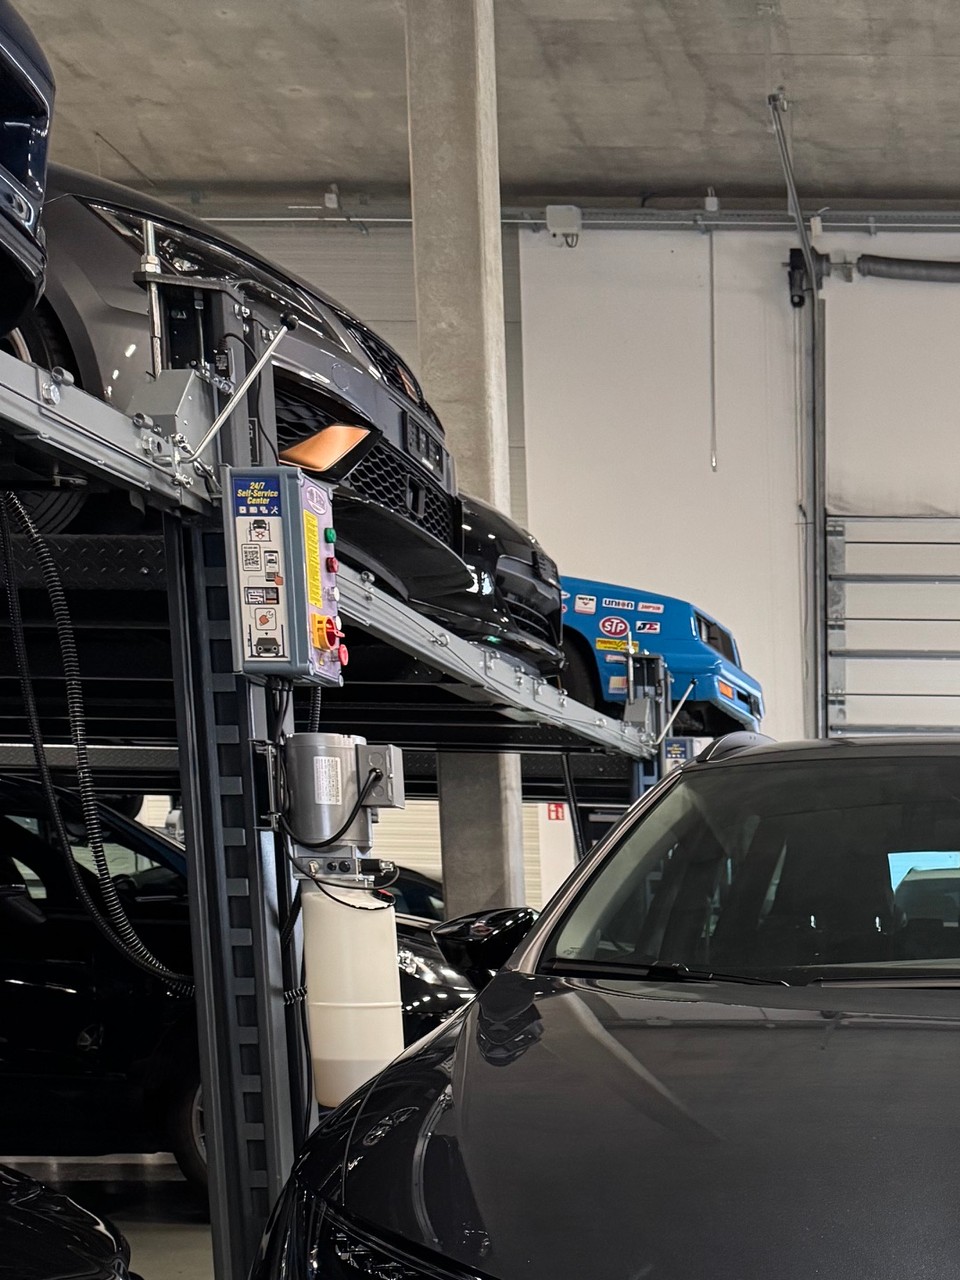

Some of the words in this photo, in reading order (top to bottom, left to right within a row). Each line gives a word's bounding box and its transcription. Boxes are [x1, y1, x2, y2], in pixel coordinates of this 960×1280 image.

[250, 482, 265, 490] 24/7
[237, 489, 279, 498] Self-Service
[247, 497, 270, 505] Center
[604, 619, 626, 633] STP
[637, 622, 658, 632] JE
